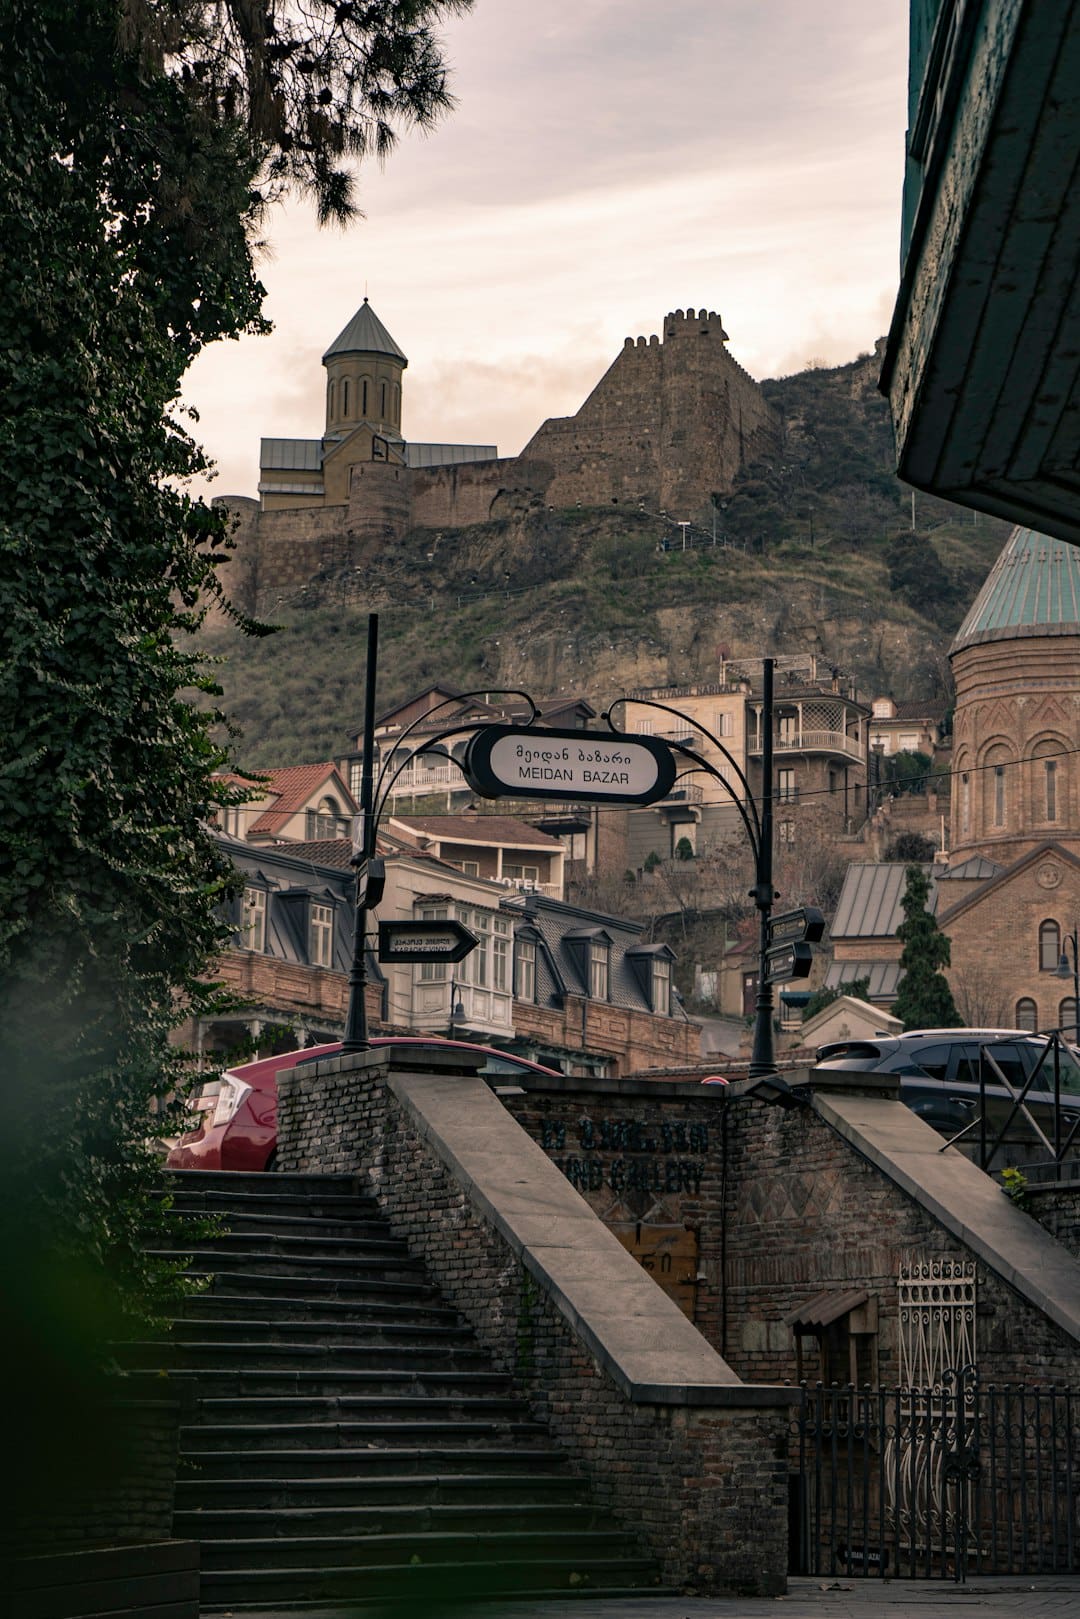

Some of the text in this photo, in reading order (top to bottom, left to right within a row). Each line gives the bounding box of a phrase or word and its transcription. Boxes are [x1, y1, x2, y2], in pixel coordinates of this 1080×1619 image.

[696, 684, 742, 697] NARIKALA
[516, 745, 631, 765] მეიდან ბაზარი
[519, 766, 629, 785] MEIDAN BAZAR
